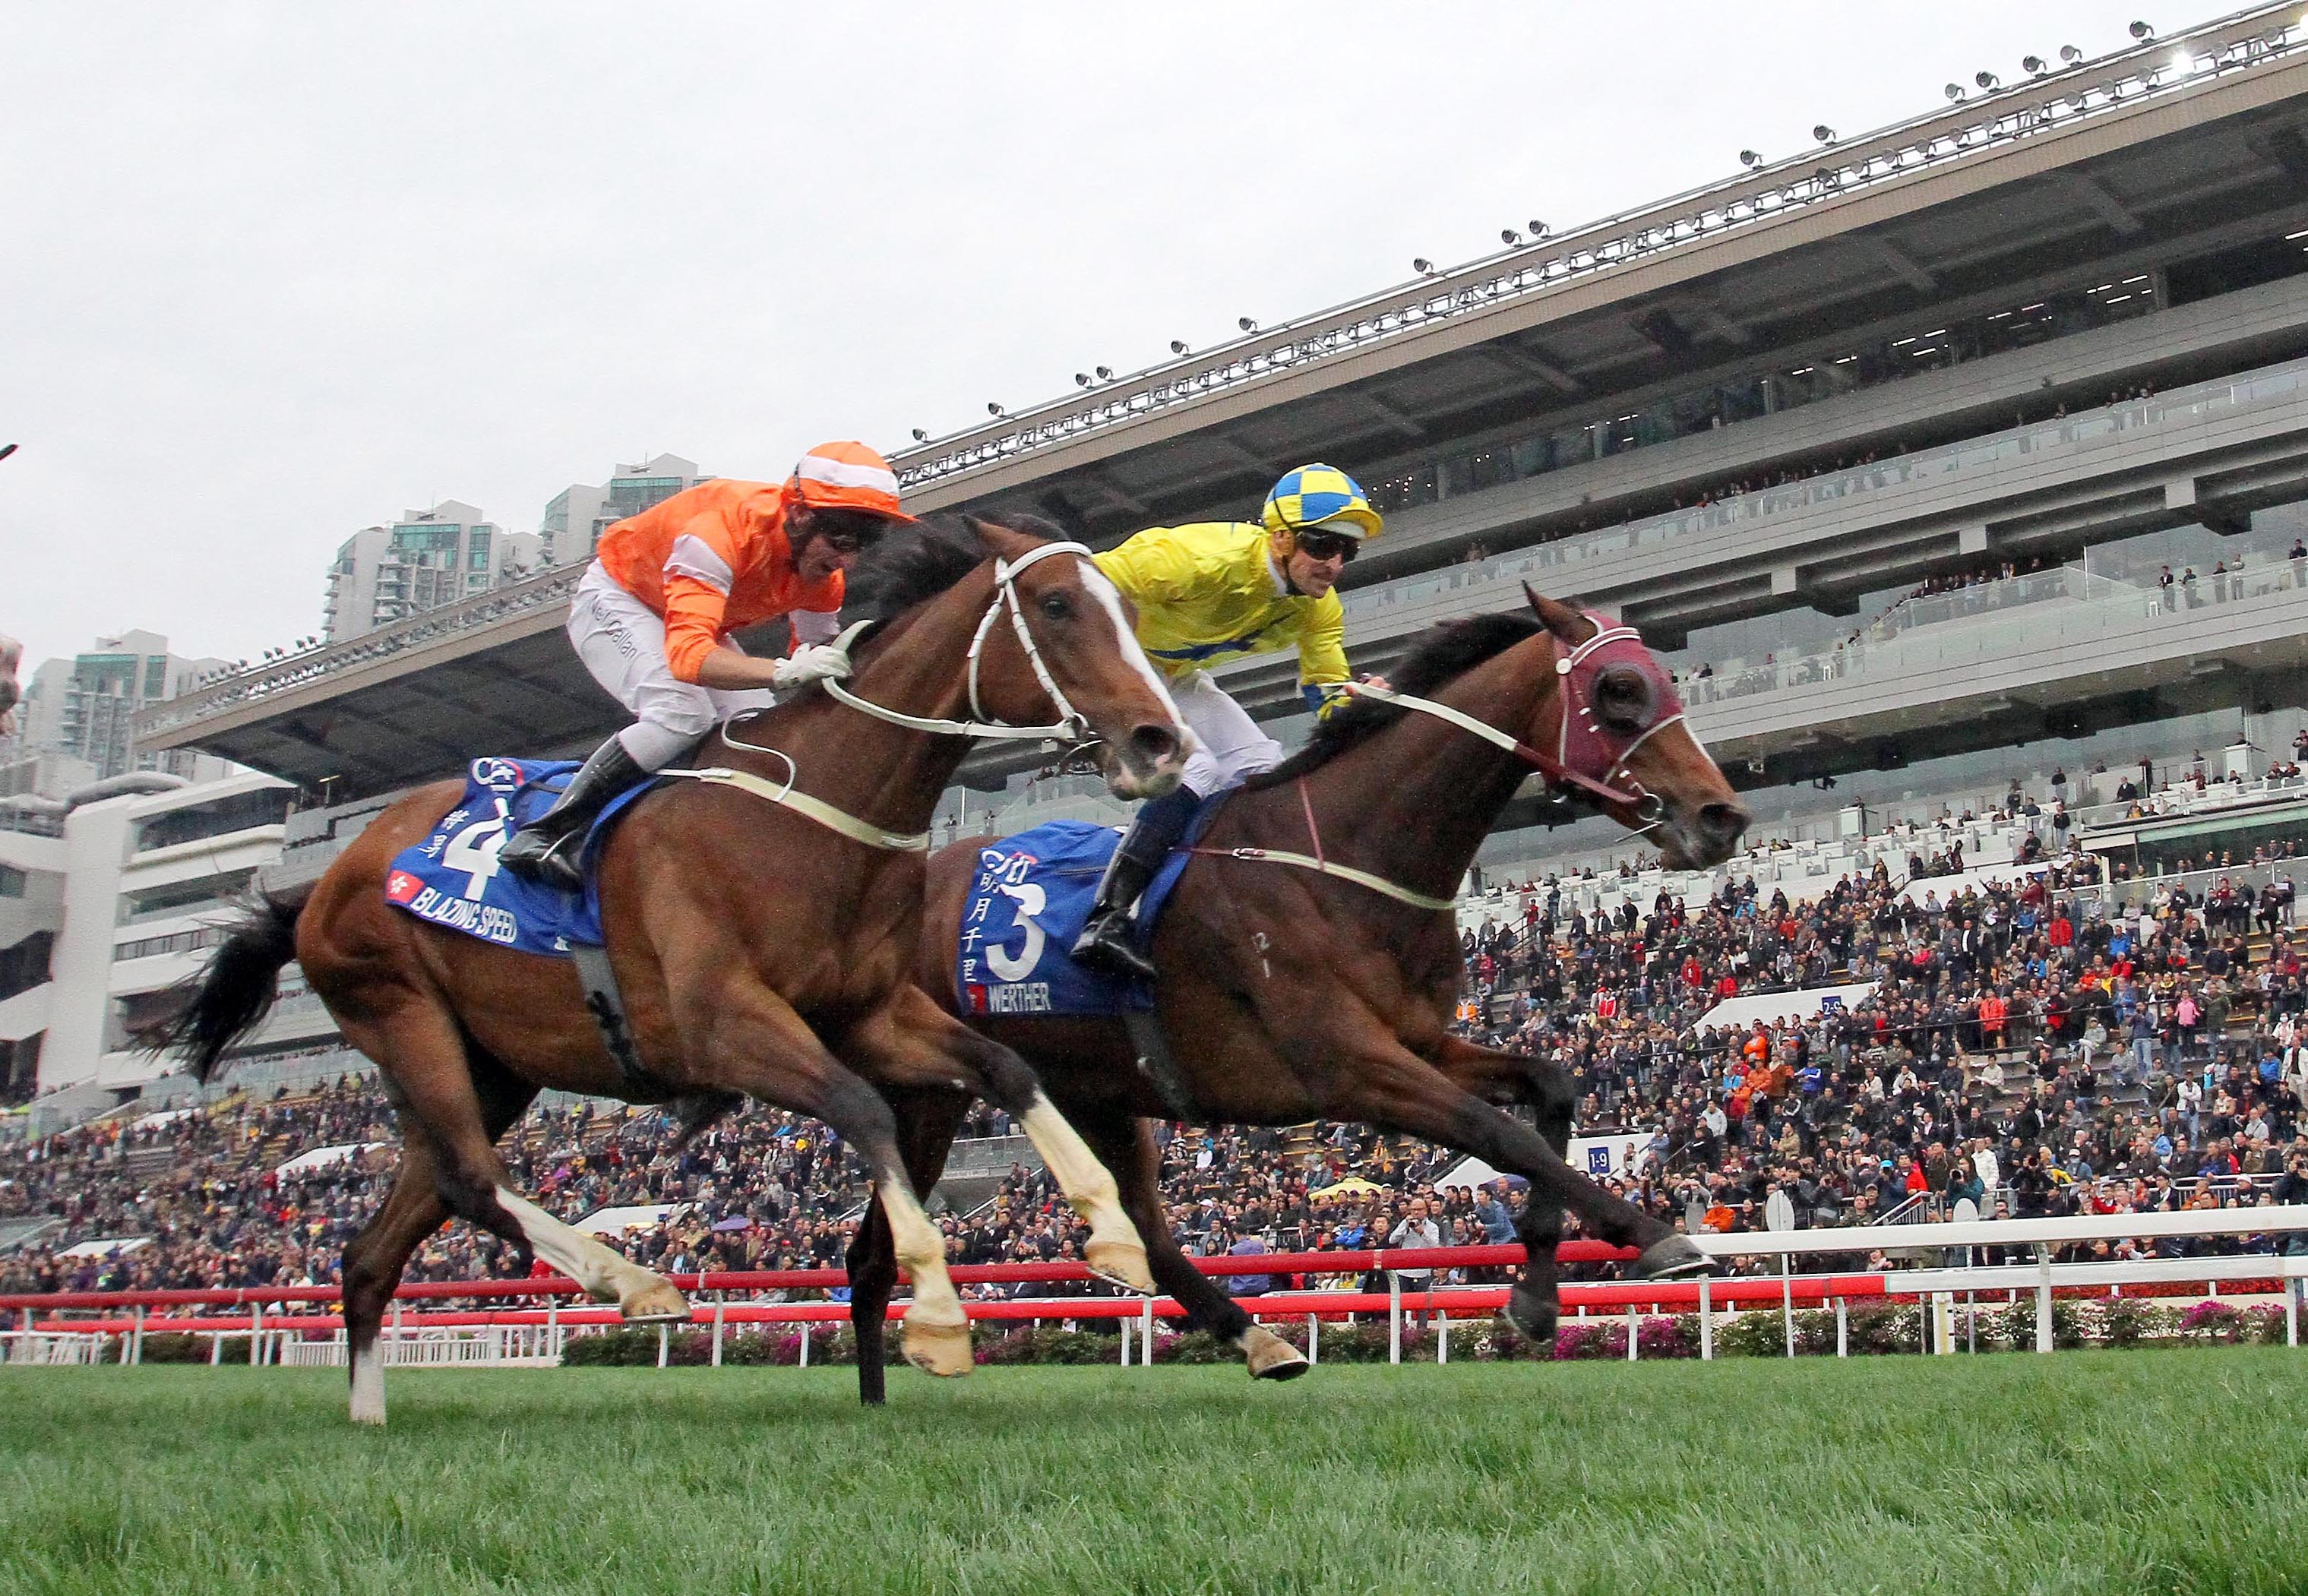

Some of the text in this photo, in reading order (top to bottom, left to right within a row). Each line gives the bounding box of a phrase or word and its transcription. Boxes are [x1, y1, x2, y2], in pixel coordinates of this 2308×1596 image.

[606, 620, 638, 659] Callan
[442, 798, 510, 902] 4
[410, 886, 518, 943] BLAZING SPEED
[985, 883, 1047, 982] 3
[988, 982, 1051, 1013] WERTHER
[1823, 1000, 1840, 1015] 2-9
[1590, 1153, 1608, 1168] 1-9
